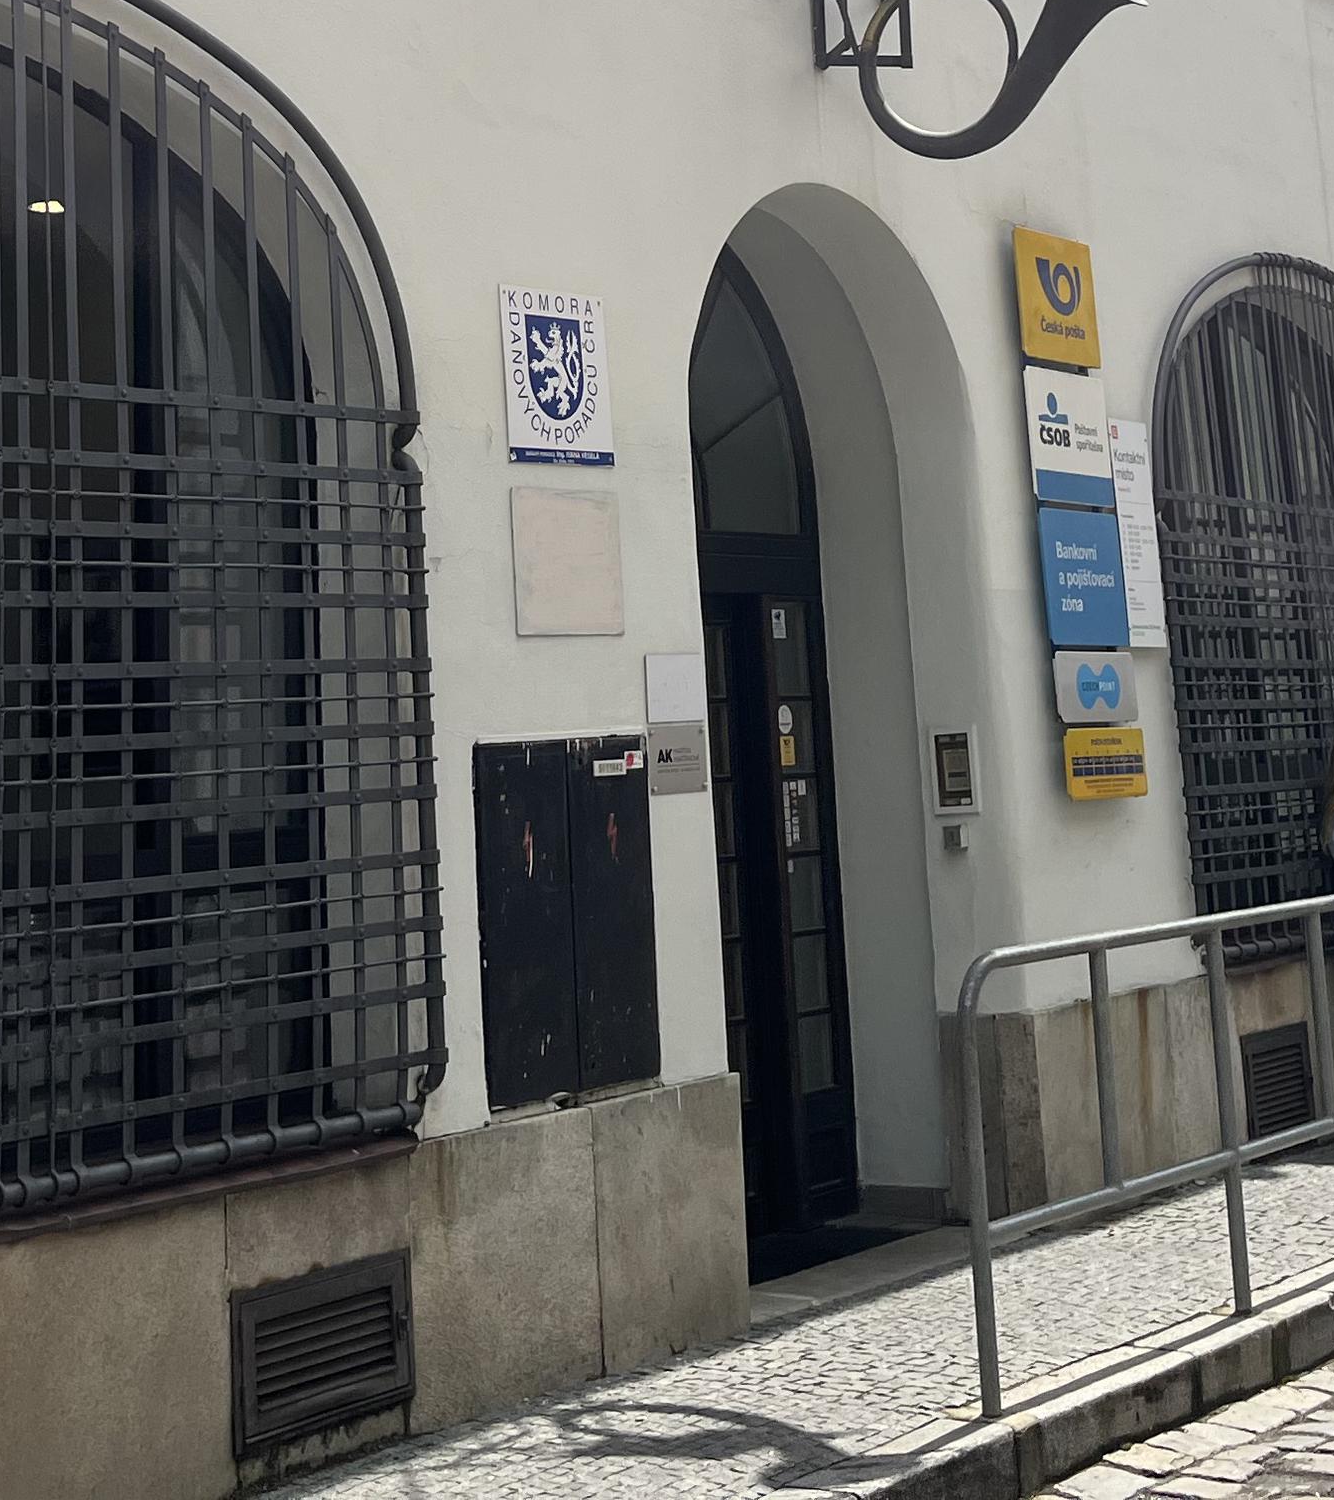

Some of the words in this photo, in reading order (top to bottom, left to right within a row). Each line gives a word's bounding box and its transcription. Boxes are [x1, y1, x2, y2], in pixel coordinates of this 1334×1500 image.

[507, 289, 593, 317] KOMORA
[1040, 315, 1064, 335] Česká
[1064, 322, 1086, 341] pošta
[508, 311, 552, 442] DAŇOVÝCH
[554, 364, 599, 446] PORADCŮ
[582, 320, 596, 354] ČR
[1039, 422, 1071, 448] ČSOB
[1113, 447, 1146, 465] Kontaktní
[1114, 466, 1135, 481] místo
[1055, 540, 1098, 561] Bankovní
[1058, 570, 1066, 585] a
[1066, 569, 1116, 590] pojišťovací
[1061, 594, 1084, 612] zóna
[657, 749, 673, 764] AK
